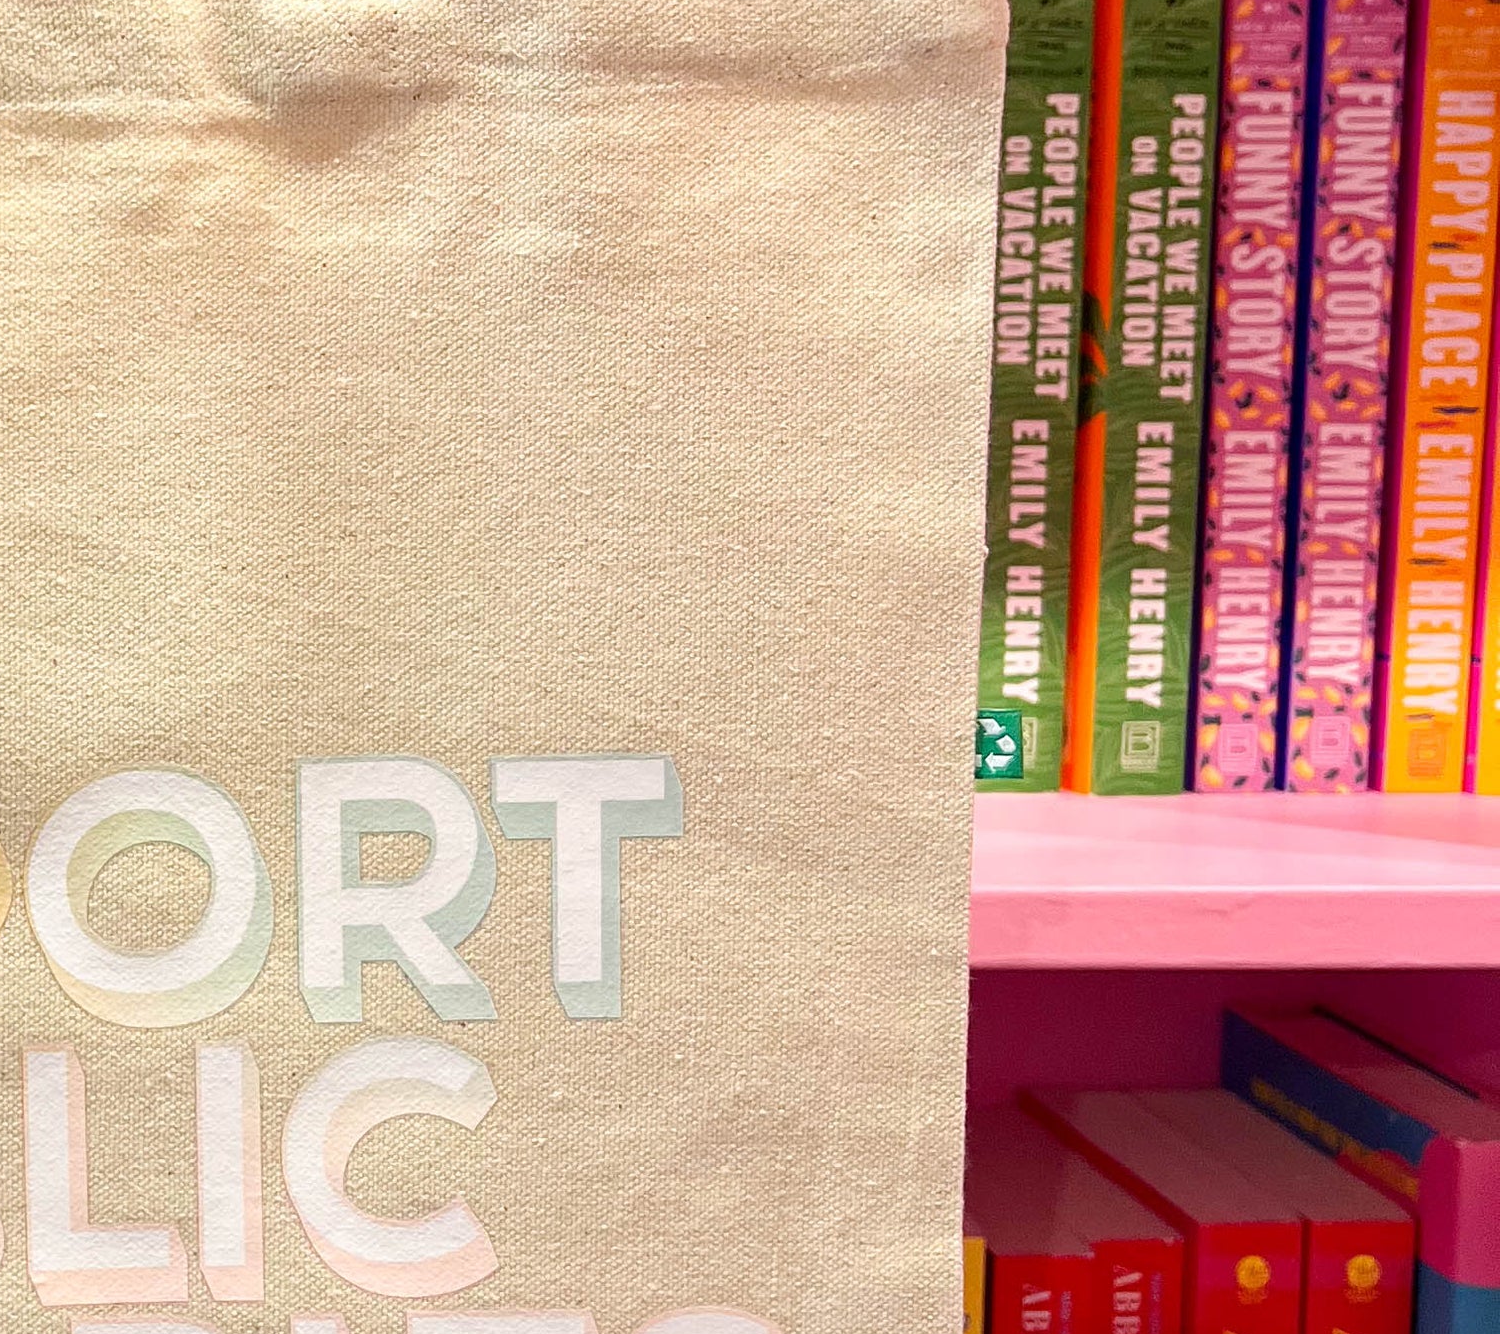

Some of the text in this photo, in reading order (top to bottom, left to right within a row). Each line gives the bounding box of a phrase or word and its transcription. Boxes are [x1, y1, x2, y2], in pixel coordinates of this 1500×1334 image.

[1041, 93, 1080, 227] PEOPLE
[1166, 94, 1207, 228] PEOPLE
[1232, 92, 1293, 228] FUNNY
[1332, 83, 1394, 222] FUNNY
[997, 135, 1036, 365] ON VACATION
[1039, 238, 1073, 293] WE
[1122, 136, 1162, 366] ON VACATION
[1164, 238, 1199, 294] WE
[1226, 244, 1285, 379] STORY
[1324, 237, 1382, 371] STORY
[1034, 303, 1070, 401] MEET
[1159, 304, 1196, 403] MEET
[1403, 91, 1495, 714] HAPPY PLACE EMILY HENRY
[1220, 430, 1276, 548] EMILY
[1314, 423, 1372, 541] EMILY
[1002, 419, 1050, 704] EMILY HENRY
[1125, 421, 1174, 708] EMILY HENRY
[1215, 566, 1270, 691] HENRY
[1307, 560, 1364, 684] HENRY
